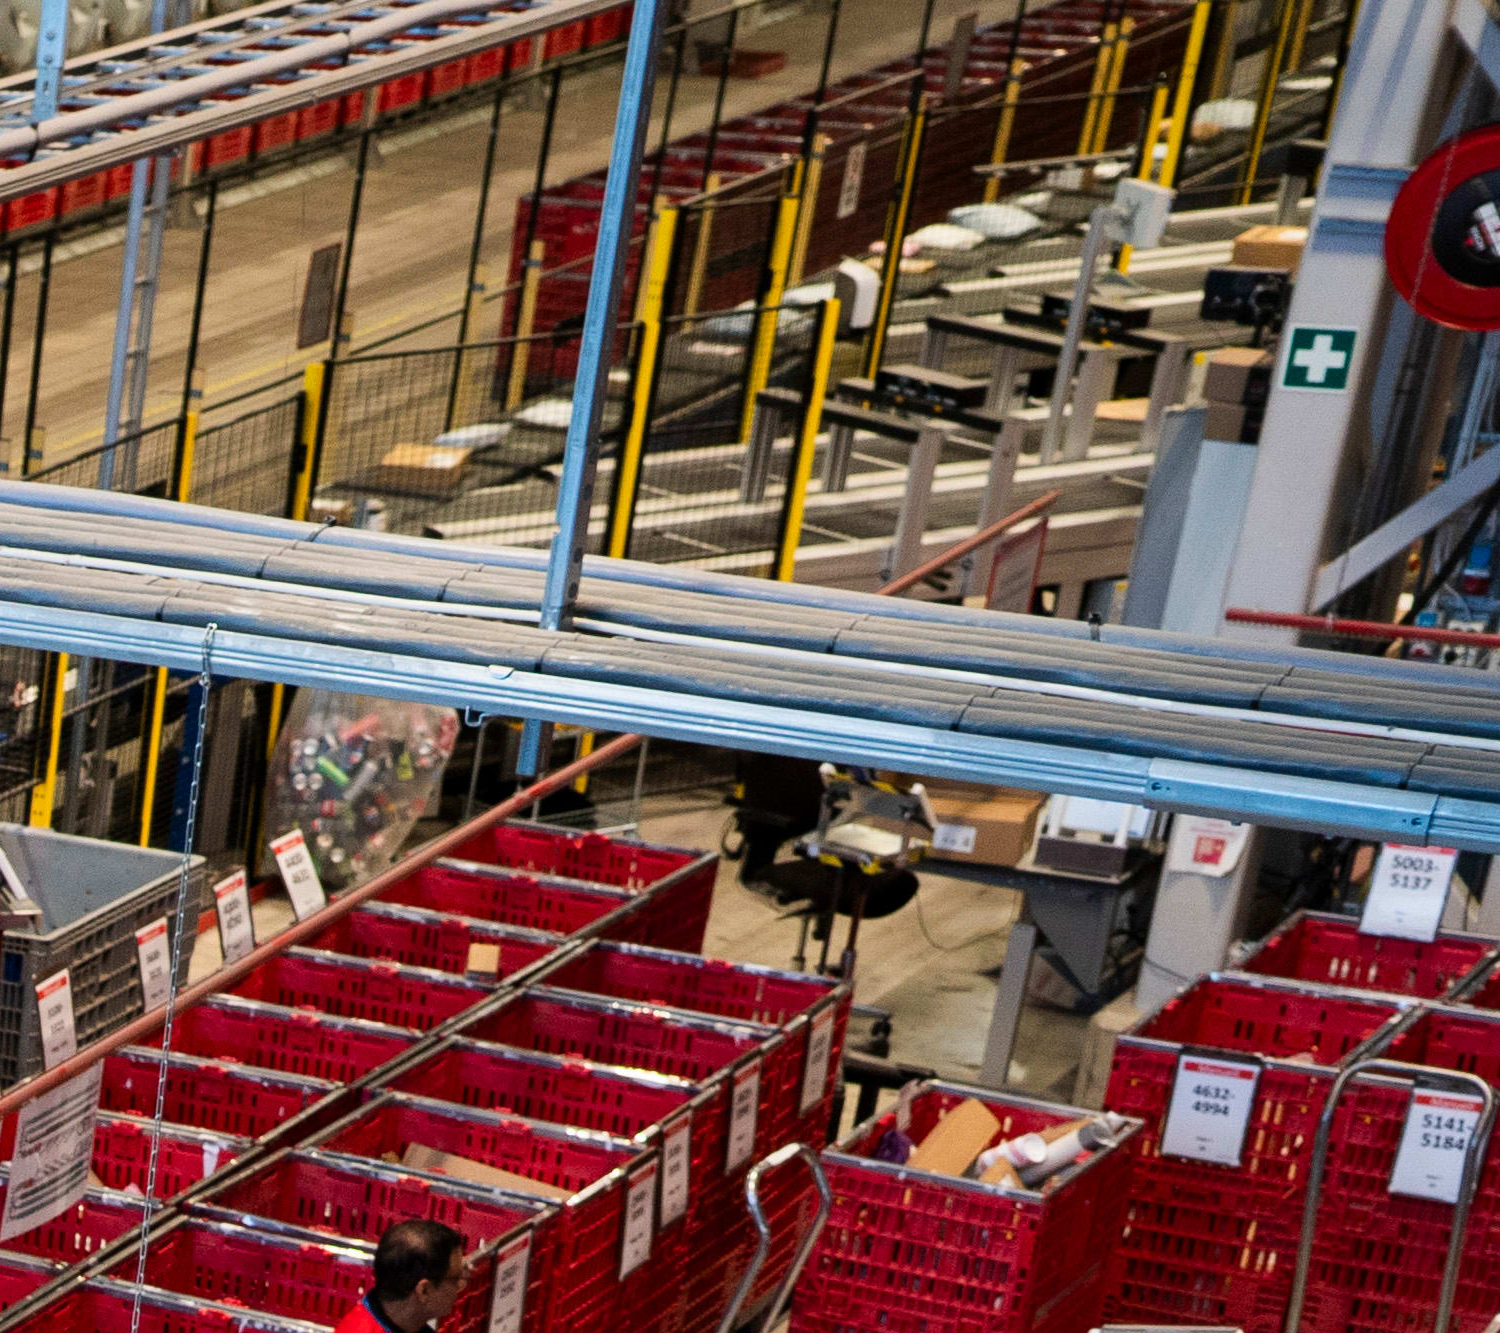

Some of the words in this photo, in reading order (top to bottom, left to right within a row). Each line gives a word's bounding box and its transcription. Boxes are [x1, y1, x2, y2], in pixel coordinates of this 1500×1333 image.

[1392, 855, 1439, 873] 5003-
[1390, 873, 1432, 890] 5137
[1193, 1084, 1235, 1099] 4632-
[1192, 1101, 1230, 1116] 4994
[1422, 1114, 1473, 1133] 5141-
[1421, 1133, 1465, 1152] 5184
